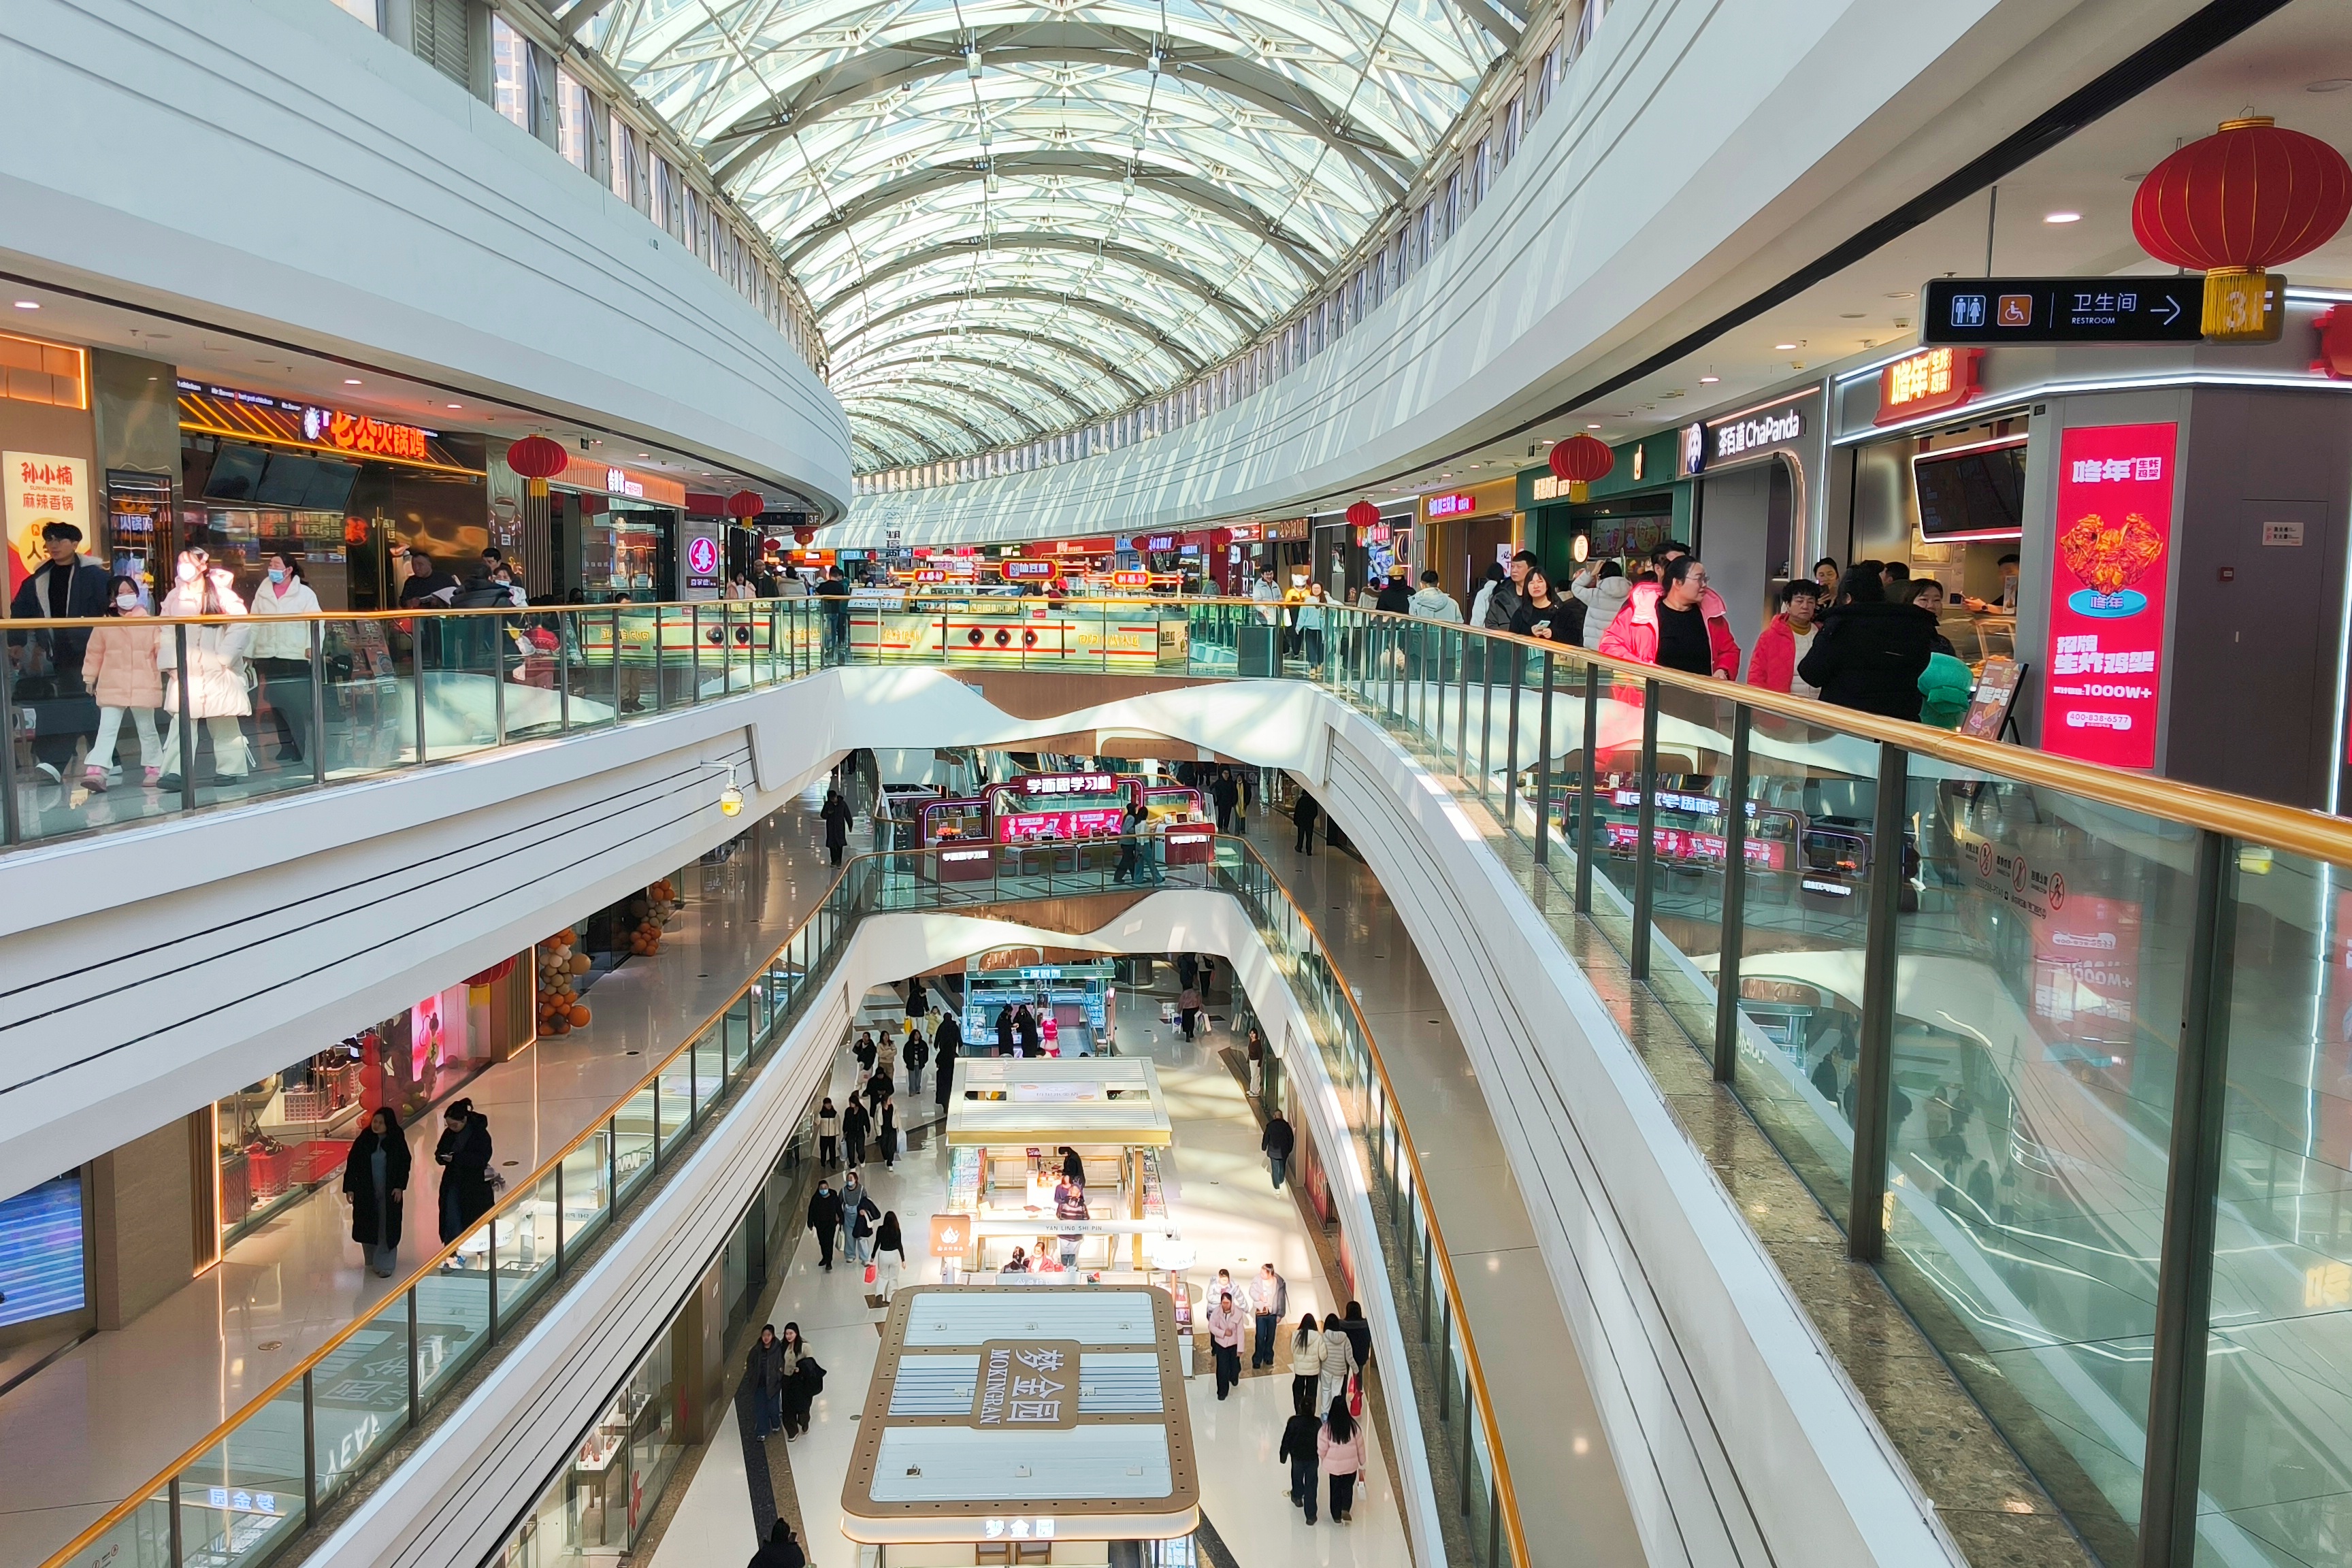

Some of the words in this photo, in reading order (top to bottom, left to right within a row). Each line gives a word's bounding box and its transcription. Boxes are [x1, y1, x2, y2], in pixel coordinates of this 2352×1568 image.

[2072, 293, 2137, 312] 卫生间
[1718, 421, 1746, 457] 茶百道
[1746, 409, 1799, 448] ChaPanda
[2138, 459, 2159, 468] 生炸
[21, 461, 73, 486] 孙小楠
[23, 493, 74, 511] 麻辣香锅
[808, 515, 819, 523] 3F
[2057, 635, 2098, 653] 招牌
[2054, 651, 2155, 674] 生炸鸡架
[2070, 713, 2128, 723] 400-838-6577
[1027, 776, 1112, 794] 学而思学习机
[980, 1348, 1011, 1424] MOKINGRAN
[1007, 1348, 1066, 1422] 梦金园
